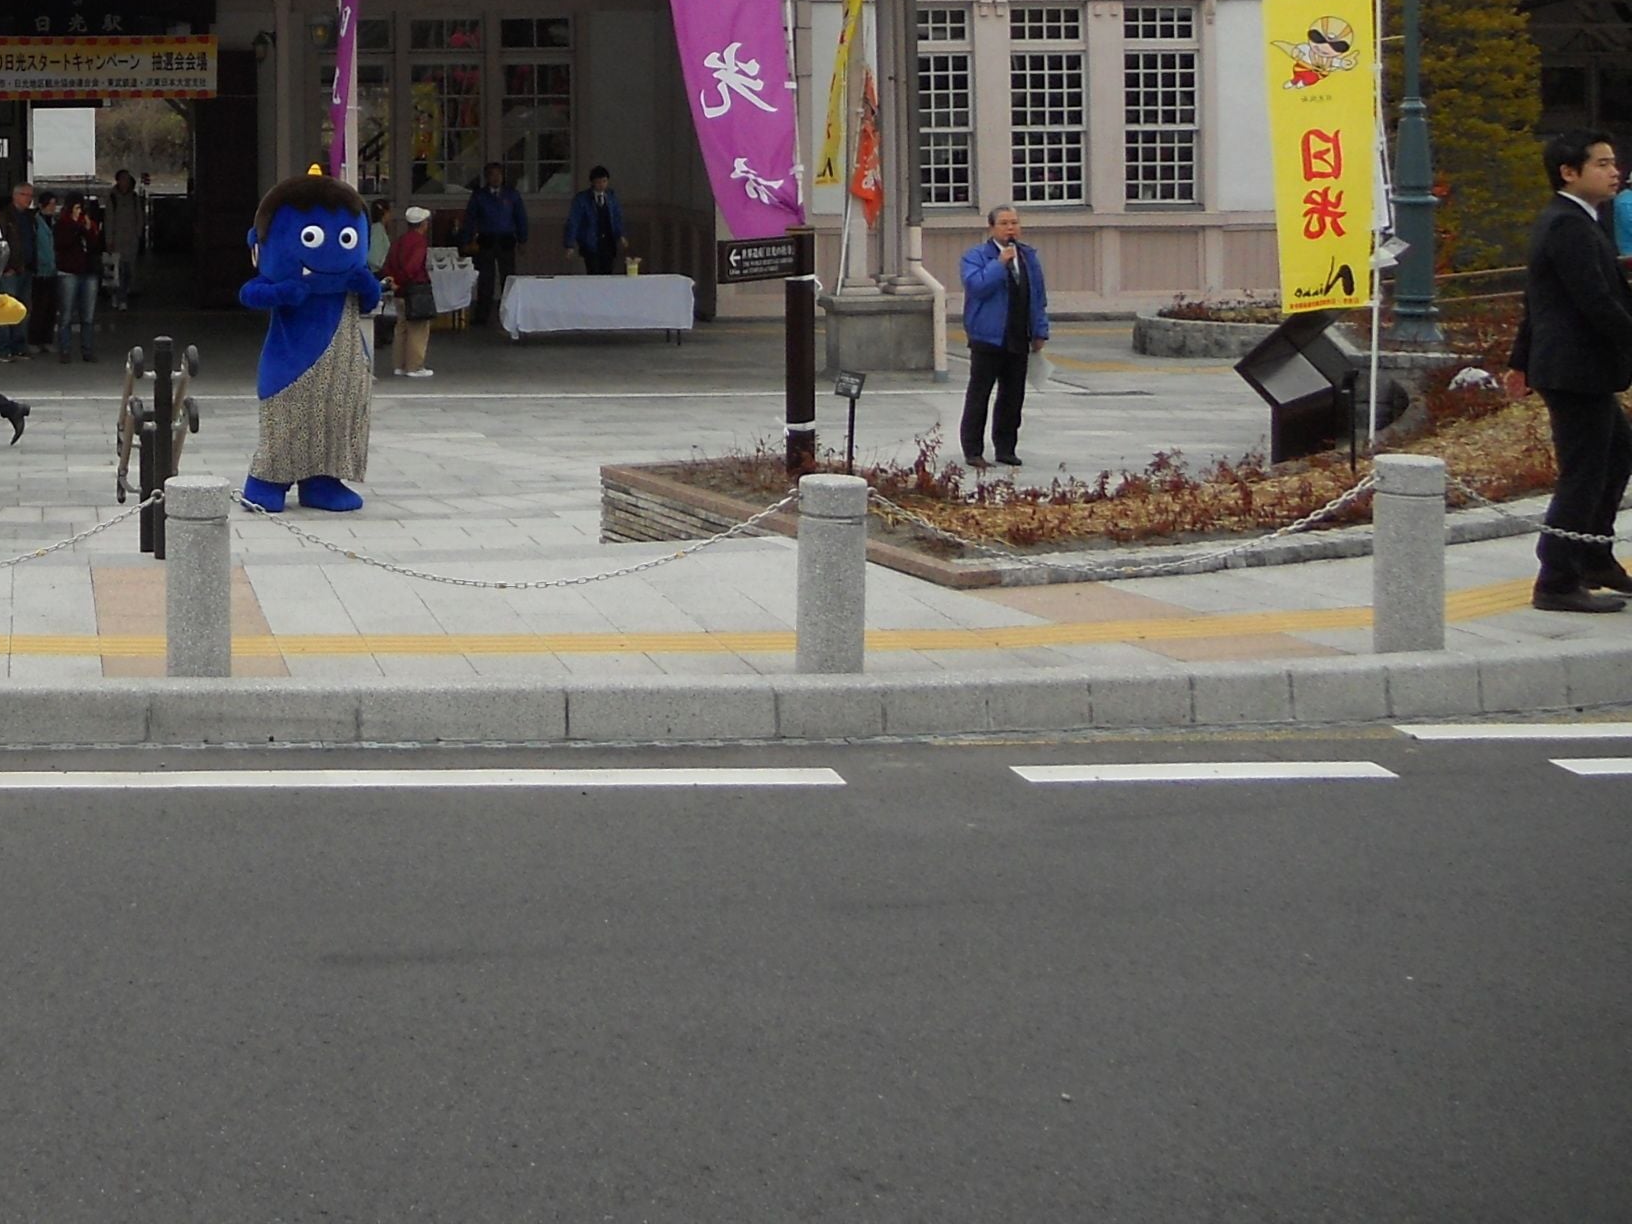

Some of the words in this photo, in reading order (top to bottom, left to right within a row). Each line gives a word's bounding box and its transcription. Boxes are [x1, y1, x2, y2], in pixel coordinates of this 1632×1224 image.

[33, 12, 124, 33] 日光駅
[151, 51, 209, 73] 抽選会会場
